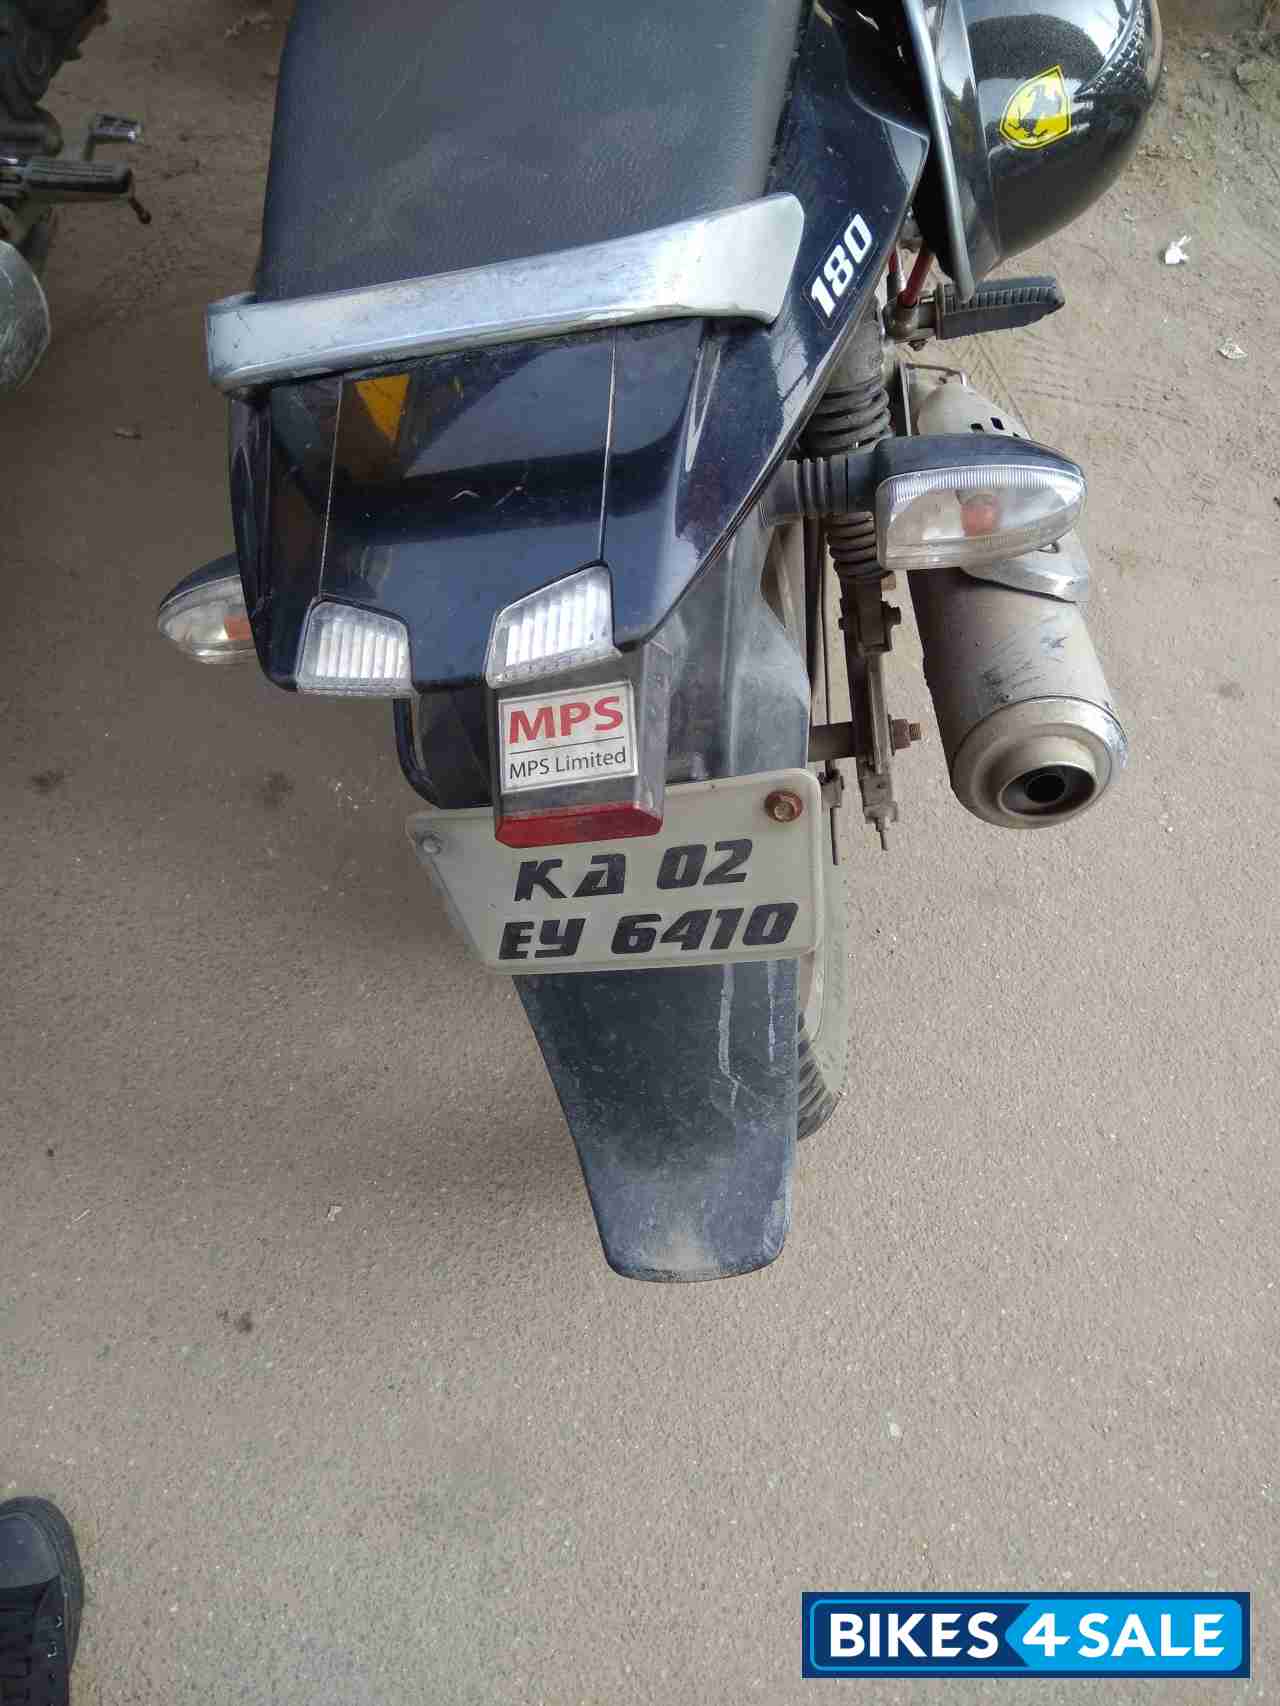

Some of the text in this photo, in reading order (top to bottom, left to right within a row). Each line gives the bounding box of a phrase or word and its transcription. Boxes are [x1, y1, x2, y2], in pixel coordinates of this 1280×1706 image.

[811, 213, 872, 318] 180
[509, 696, 623, 744] MPS
[510, 746, 626, 780] MPS Limited
[514, 838, 753, 902] KA 02
[499, 902, 798, 961] EY 6410
